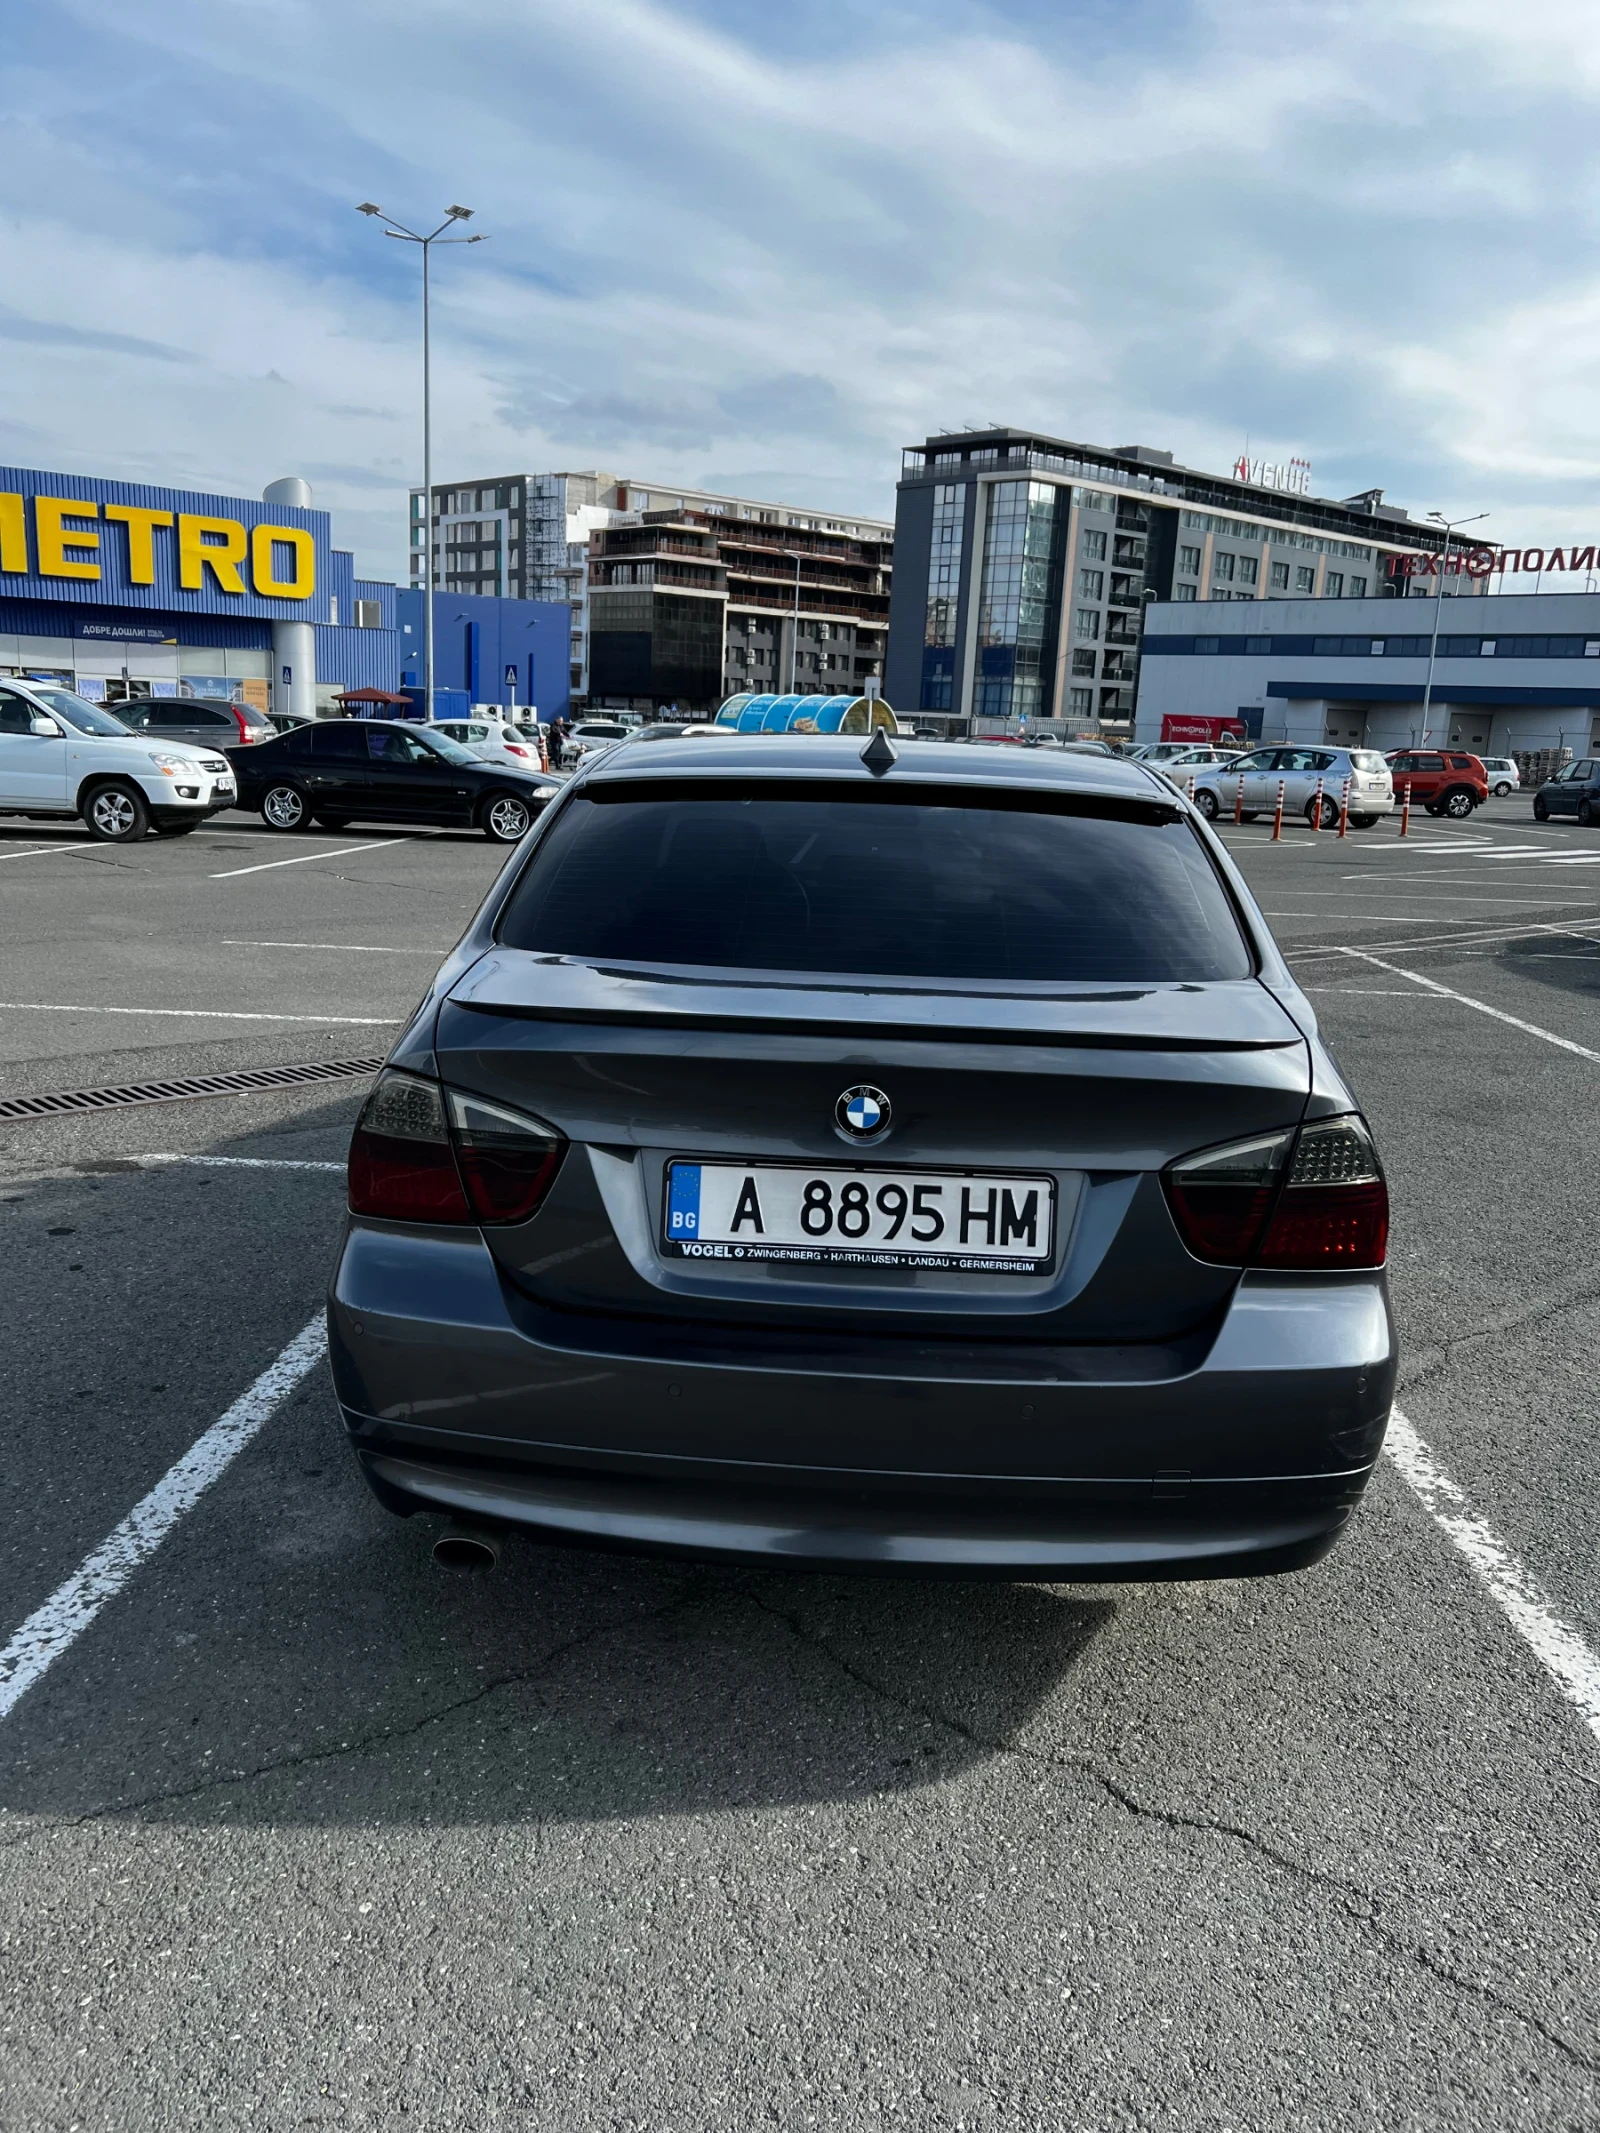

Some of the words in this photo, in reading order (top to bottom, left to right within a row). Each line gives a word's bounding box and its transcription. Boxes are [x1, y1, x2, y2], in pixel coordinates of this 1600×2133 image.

[1232, 456, 1311, 495] AVENUE
[1385, 546, 1600, 578] ТЕХНОПОЛИ
[83, 625, 111, 635] ДОБРЕ
[112, 627, 146, 637] ДОШЛИ!
[842, 1087, 887, 1106] BMW
[672, 1211, 696, 1229] BG
[730, 1176, 765, 1233] A
[800, 1179, 945, 1242] 8895
[959, 1186, 1038, 1247] HM
[682, 1243, 733, 1258] VOGEL
[747, 1248, 821, 1260] ZWINGENBERG
[830, 1252, 898, 1264] HARTHAUSEN
[908, 1256, 949, 1267] LANDAU
[959, 1259, 1035, 1271] GERMERSHEIM
